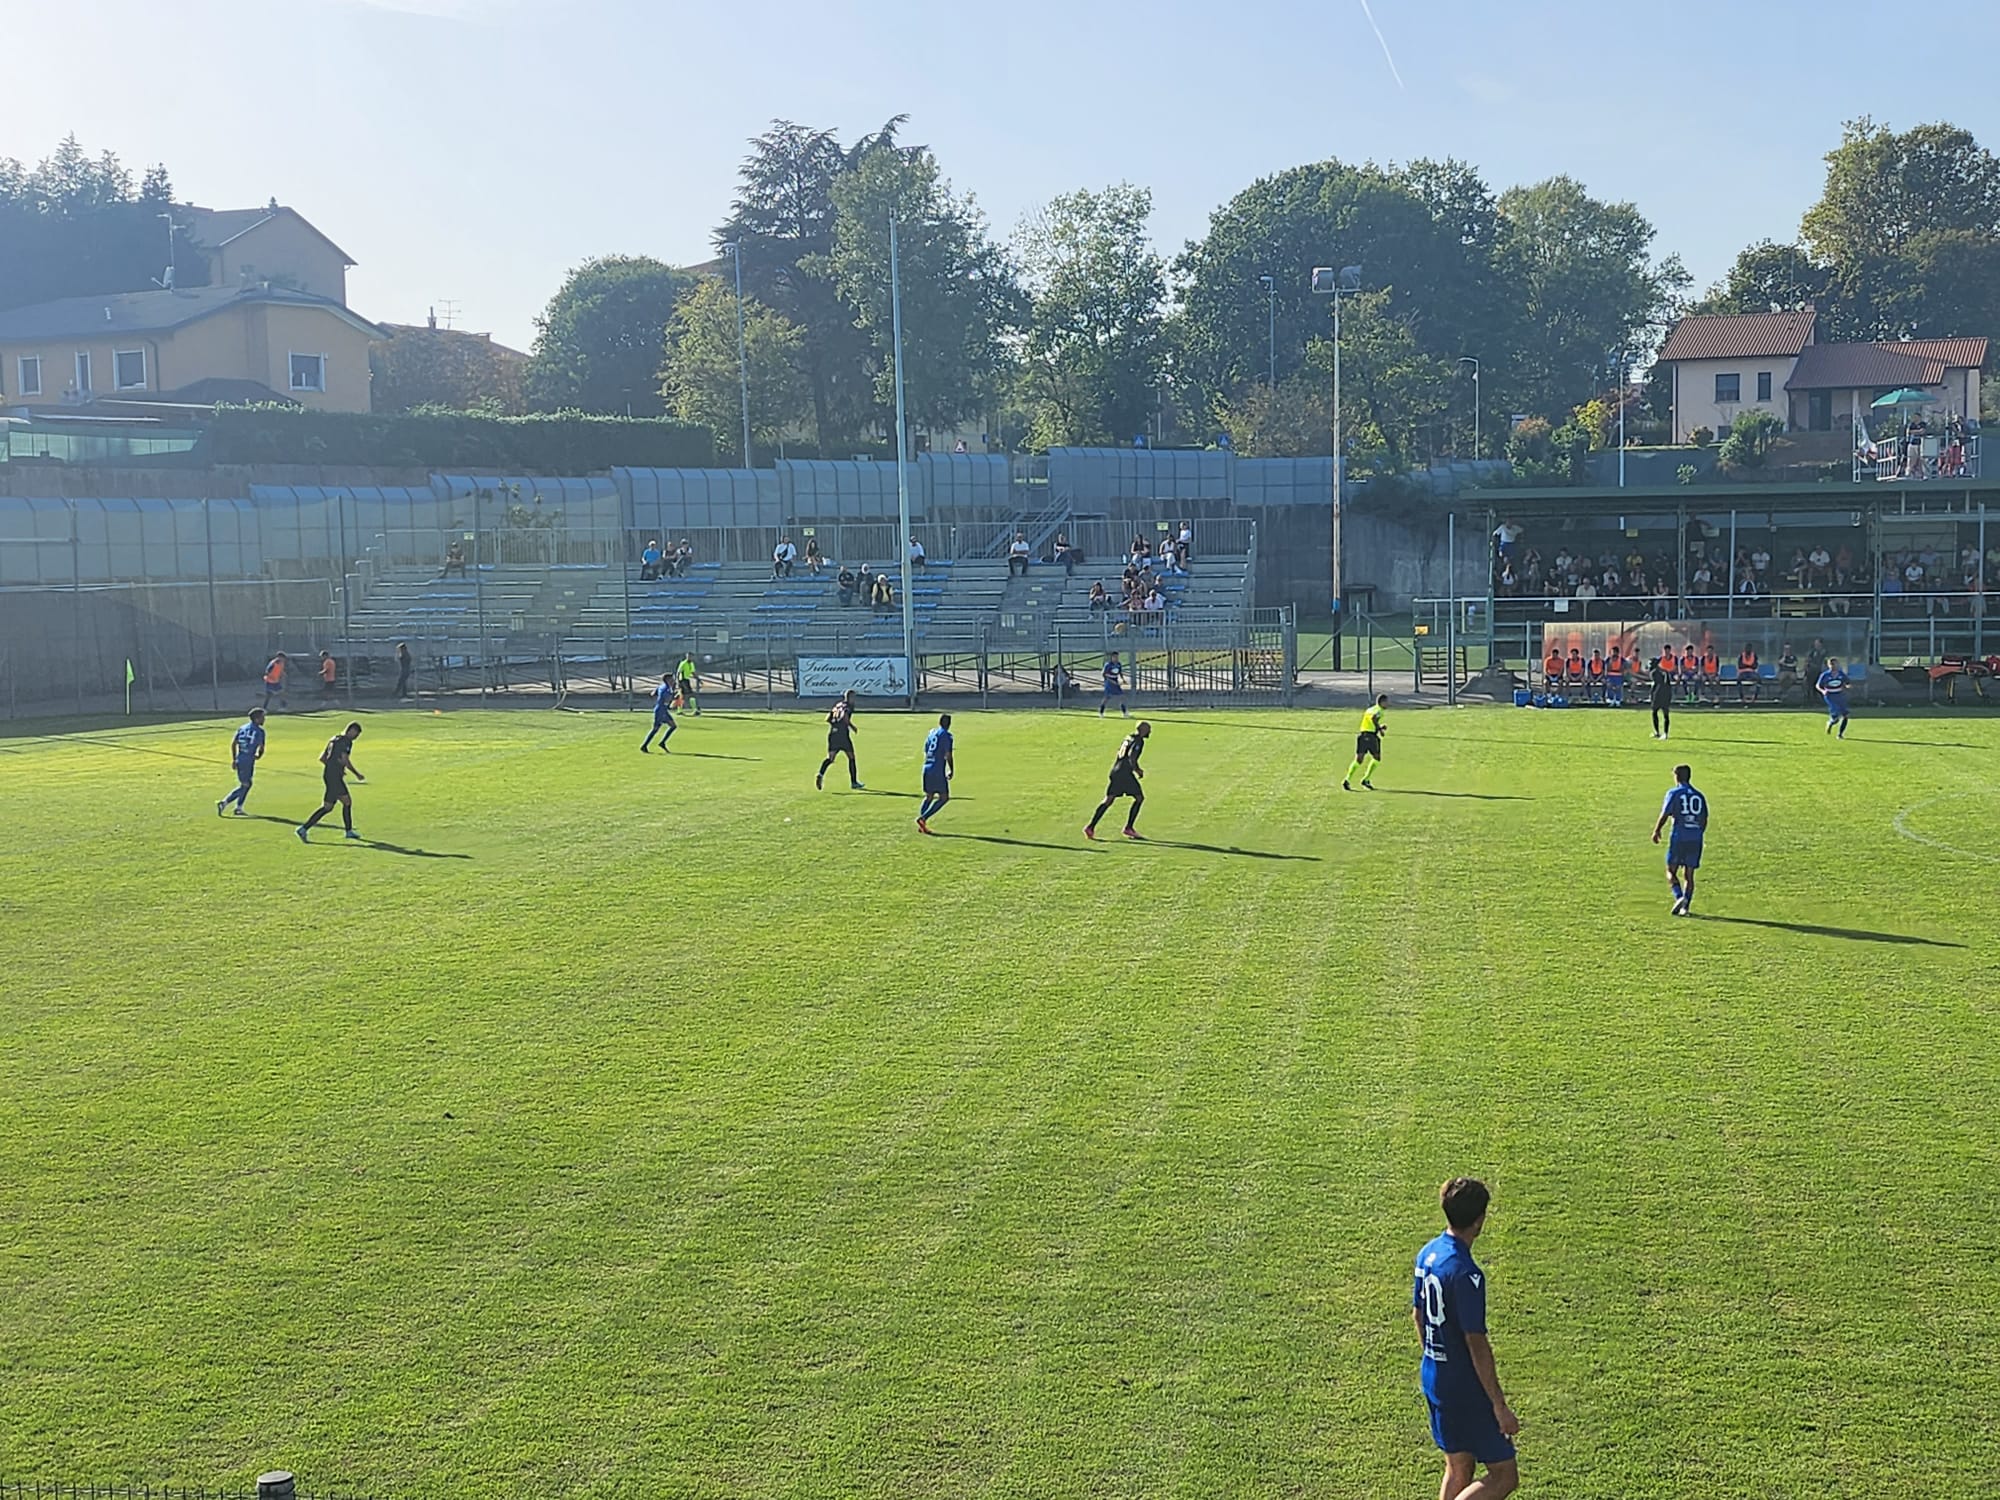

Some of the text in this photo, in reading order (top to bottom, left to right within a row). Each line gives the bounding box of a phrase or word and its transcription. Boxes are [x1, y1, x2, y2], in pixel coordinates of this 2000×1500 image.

[852, 659, 886, 673] Club
[803, 674, 838, 688] Calcio
[850, 678, 882, 689] 1974
[238, 729, 257, 745] 24
[1679, 794, 1702, 815] 10
